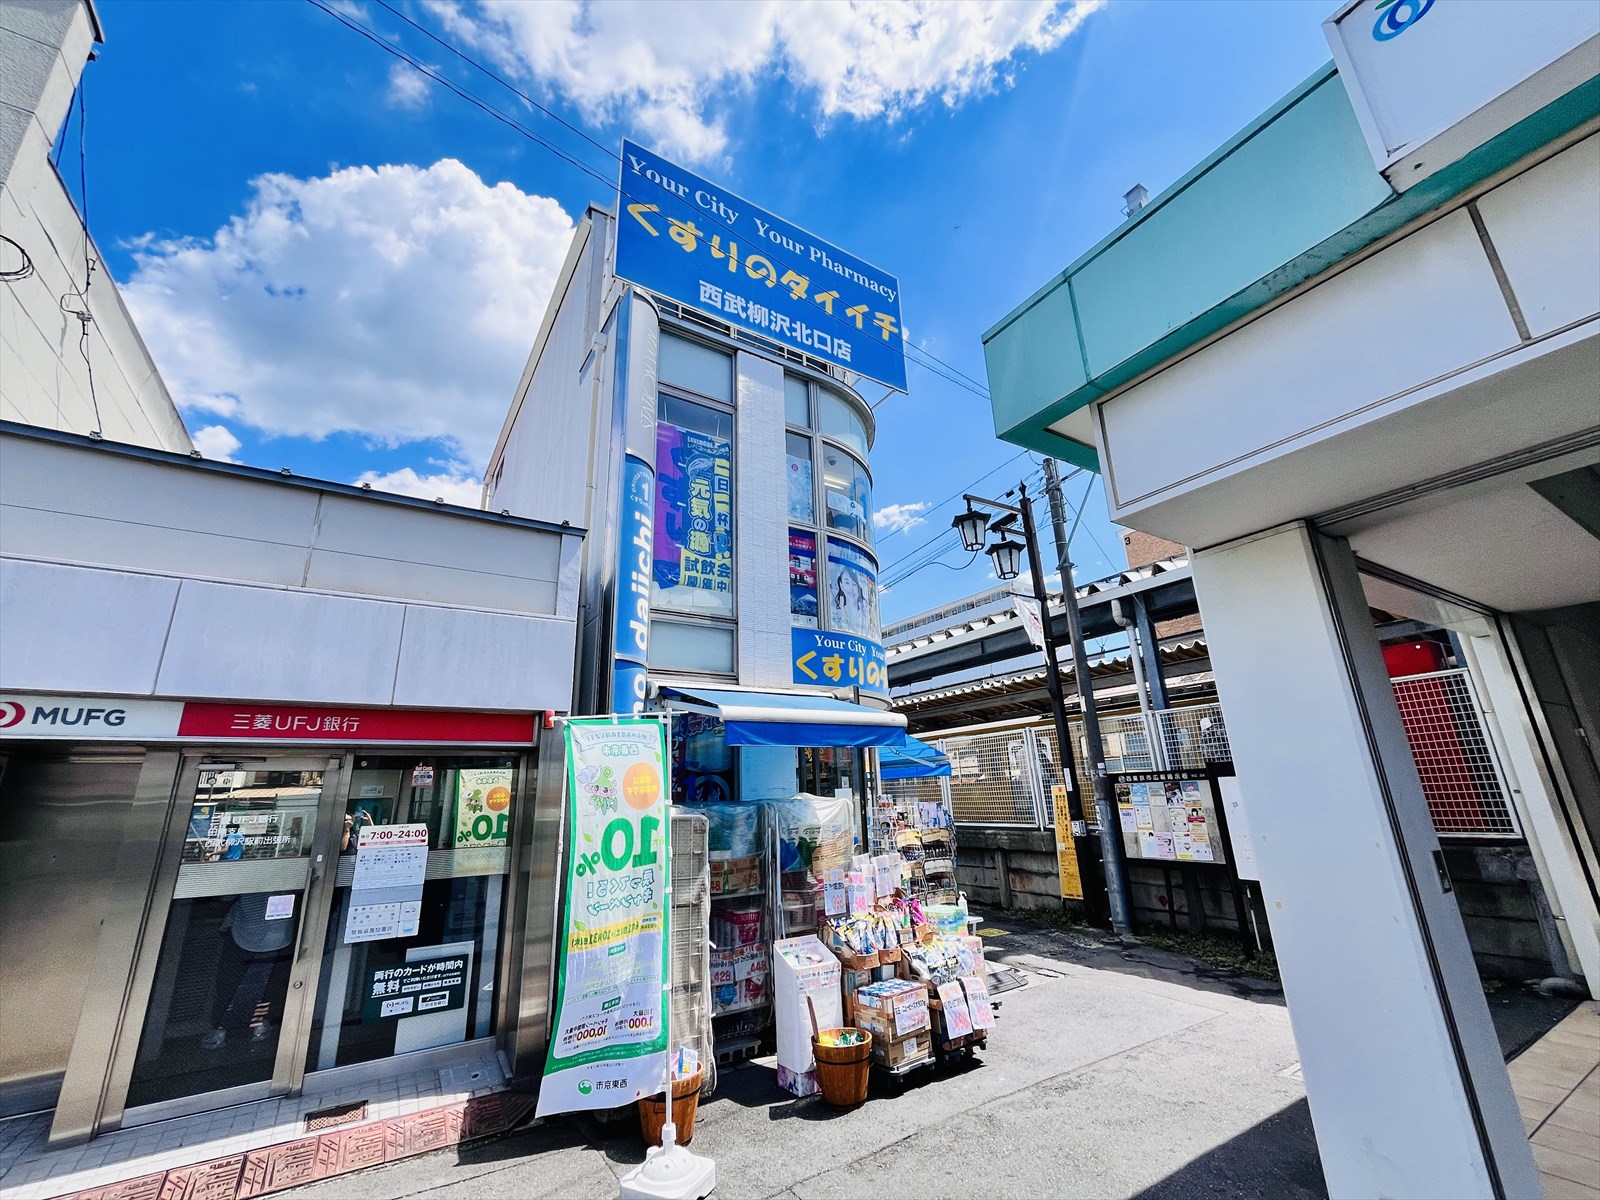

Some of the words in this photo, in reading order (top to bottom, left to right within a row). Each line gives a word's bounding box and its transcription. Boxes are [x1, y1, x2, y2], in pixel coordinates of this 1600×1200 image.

[627, 154, 689, 198] Your
[694, 190, 740, 224] City
[753, 217, 805, 256] Your
[808, 249, 898, 303] Pharmacy
[699, 279, 852, 363] 西武柳沢北口店
[1124, 536, 1132, 546] 3
[684, 555, 731, 580] 試飲会
[630, 511, 652, 650] daiichi
[686, 575, 730, 592] 開催中
[814, 634, 846, 650] Your
[847, 639, 867, 657] City
[31, 706, 127, 727] MUFG
[230, 713, 361, 732] 三菱UFJ銀行
[714, 970, 731, 982] 428
[372, 979, 400, 996] 無料
